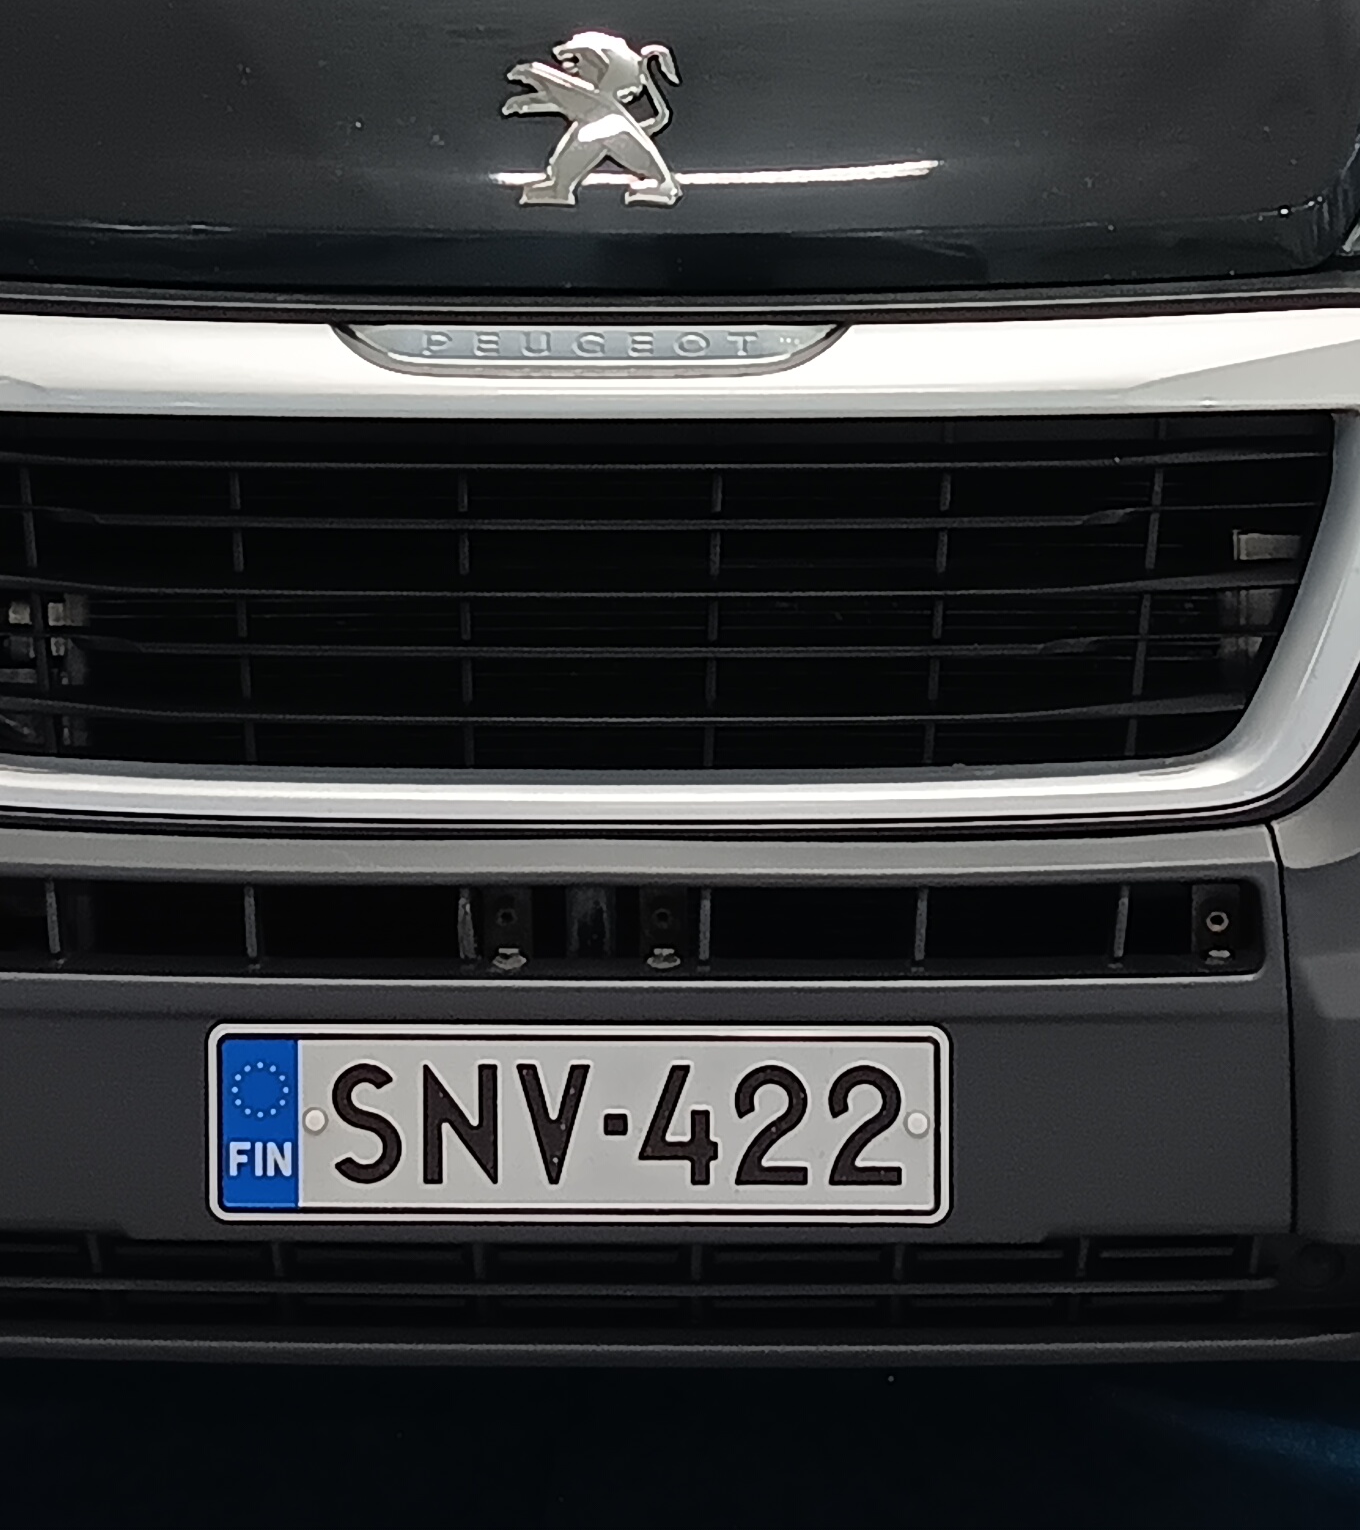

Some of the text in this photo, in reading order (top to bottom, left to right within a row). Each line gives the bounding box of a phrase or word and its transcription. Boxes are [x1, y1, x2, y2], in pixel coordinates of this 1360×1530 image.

[421, 330, 759, 358] PEUGEOT
[331, 1062, 904, 1186] SNV-422
[227, 1142, 293, 1178] FIN
